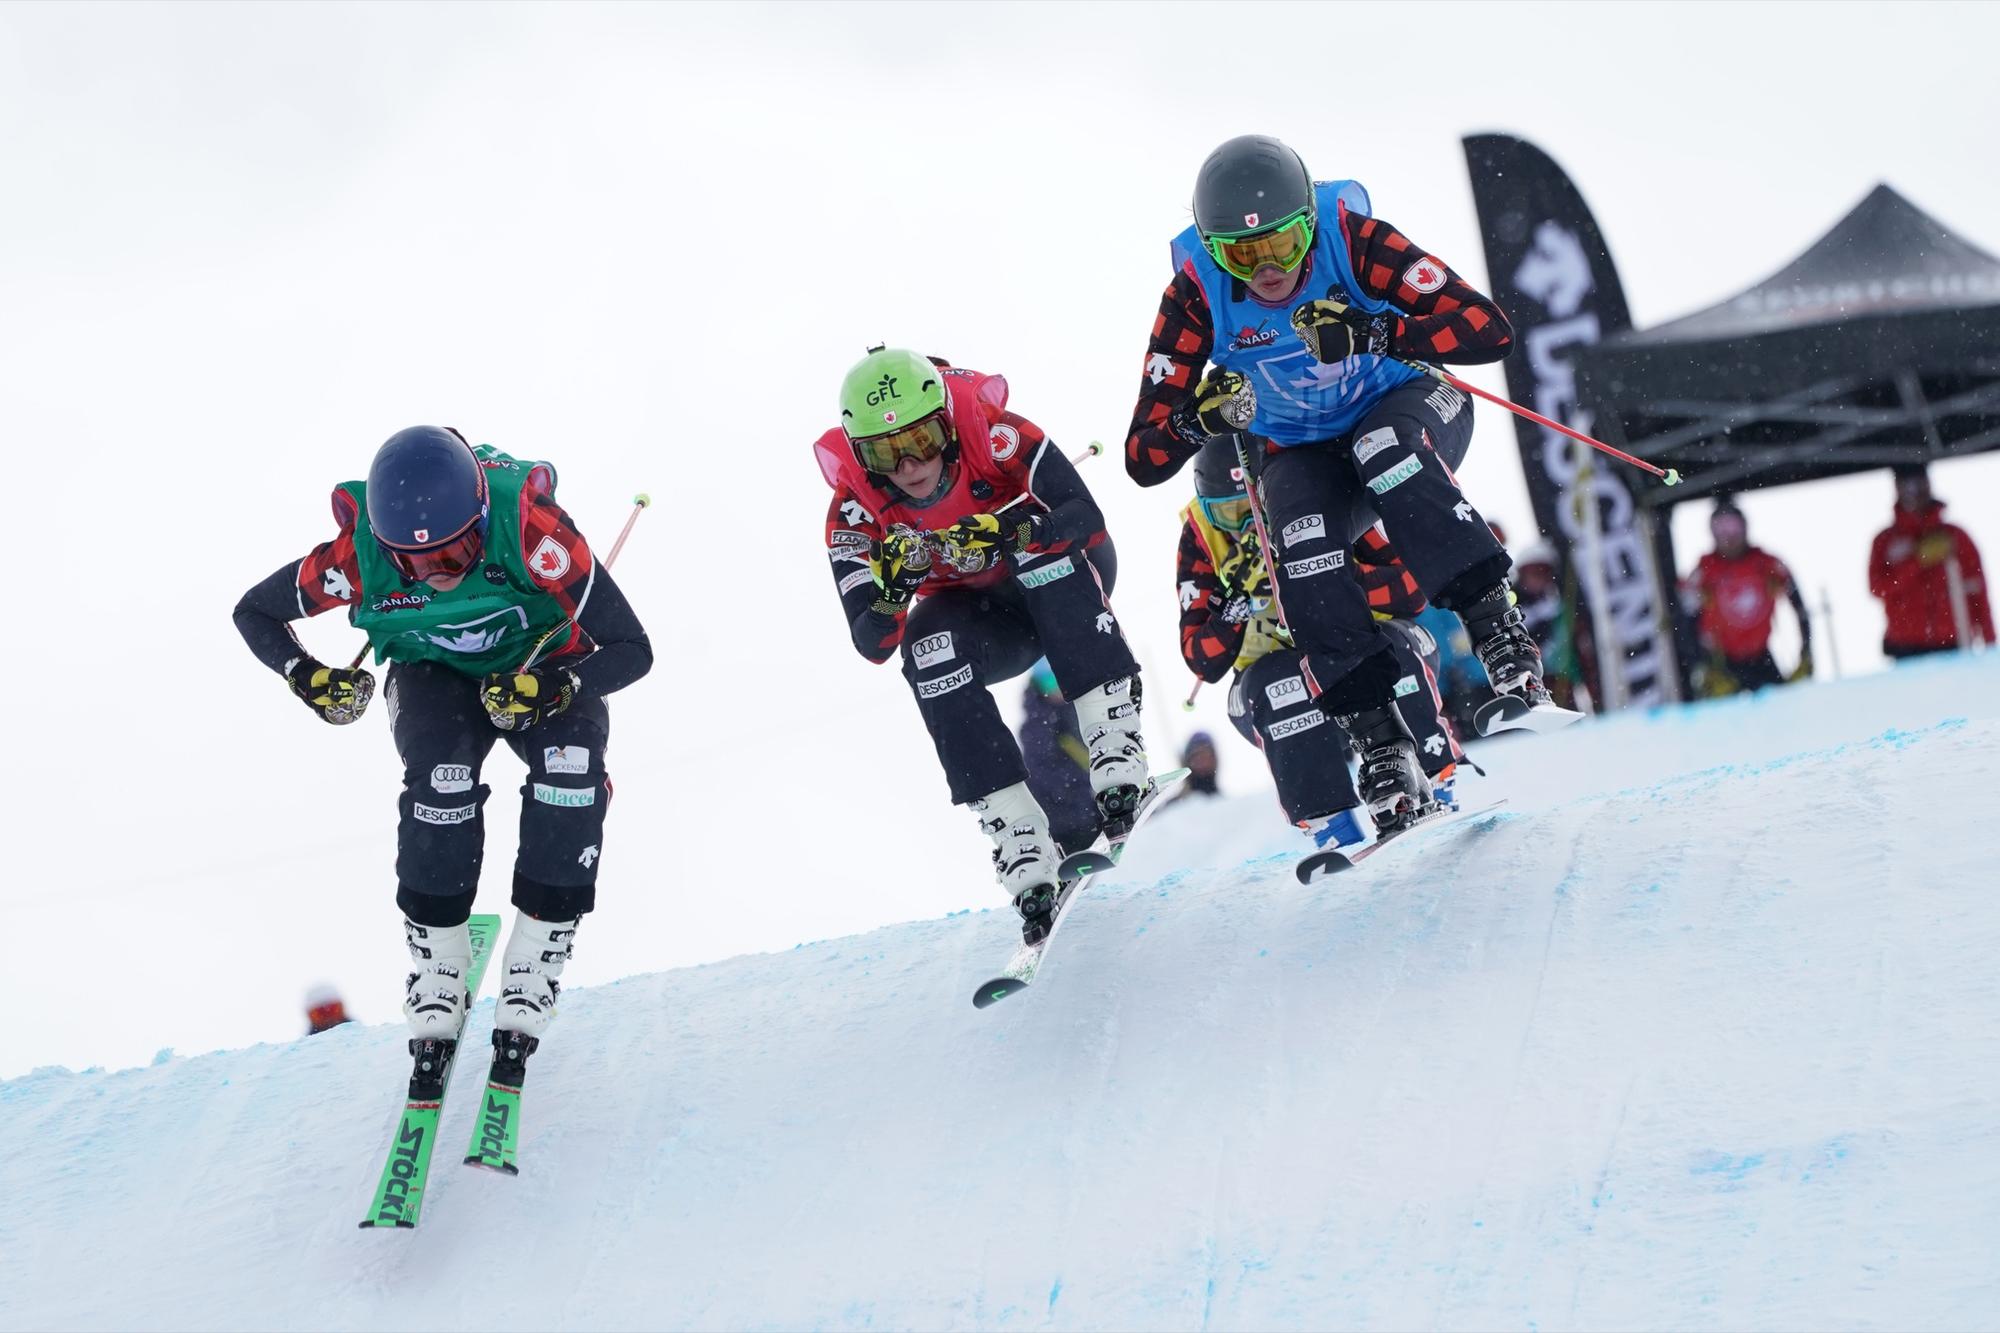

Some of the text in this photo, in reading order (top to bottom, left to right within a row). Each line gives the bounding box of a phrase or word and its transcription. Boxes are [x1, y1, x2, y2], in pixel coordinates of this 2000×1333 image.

[1228, 328, 1280, 352] CANADA
[866, 377, 901, 406] GFL
[1360, 437, 1398, 461] MACKENZIE
[1287, 553, 1343, 576] DESCENTE
[372, 594, 432, 611] CANADA
[919, 667, 972, 696] DESCENTE
[1271, 711, 1323, 738] DESCENTE
[547, 763, 588, 773] MACKENZIE
[415, 804, 475, 822] DESCENTE
